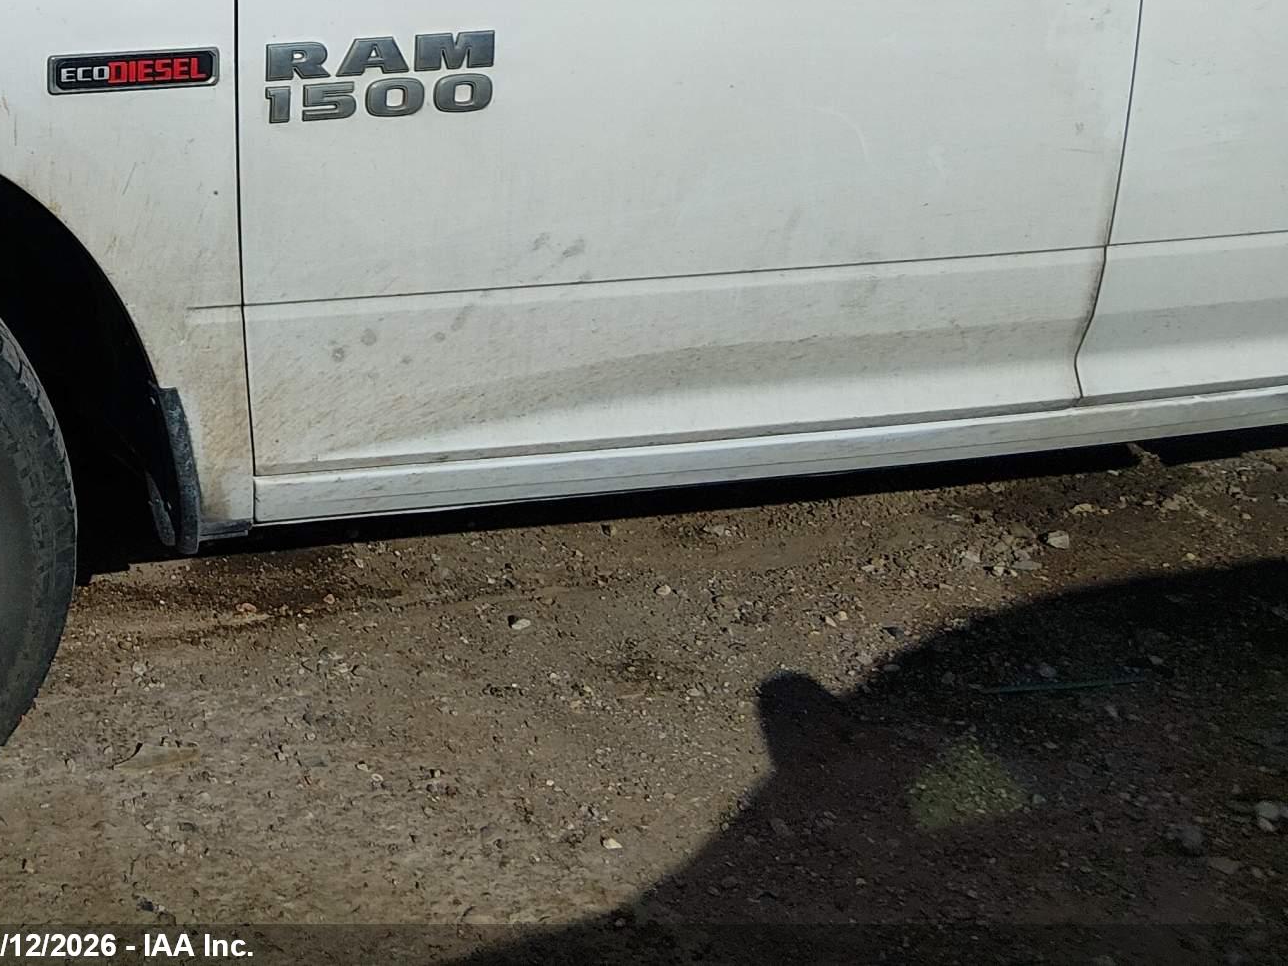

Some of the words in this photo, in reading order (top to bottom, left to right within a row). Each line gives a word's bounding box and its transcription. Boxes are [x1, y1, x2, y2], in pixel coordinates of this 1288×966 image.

[59, 56, 208, 88] ECODIESEL
[265, 30, 496, 82] RAM
[265, 73, 495, 125] 1500
